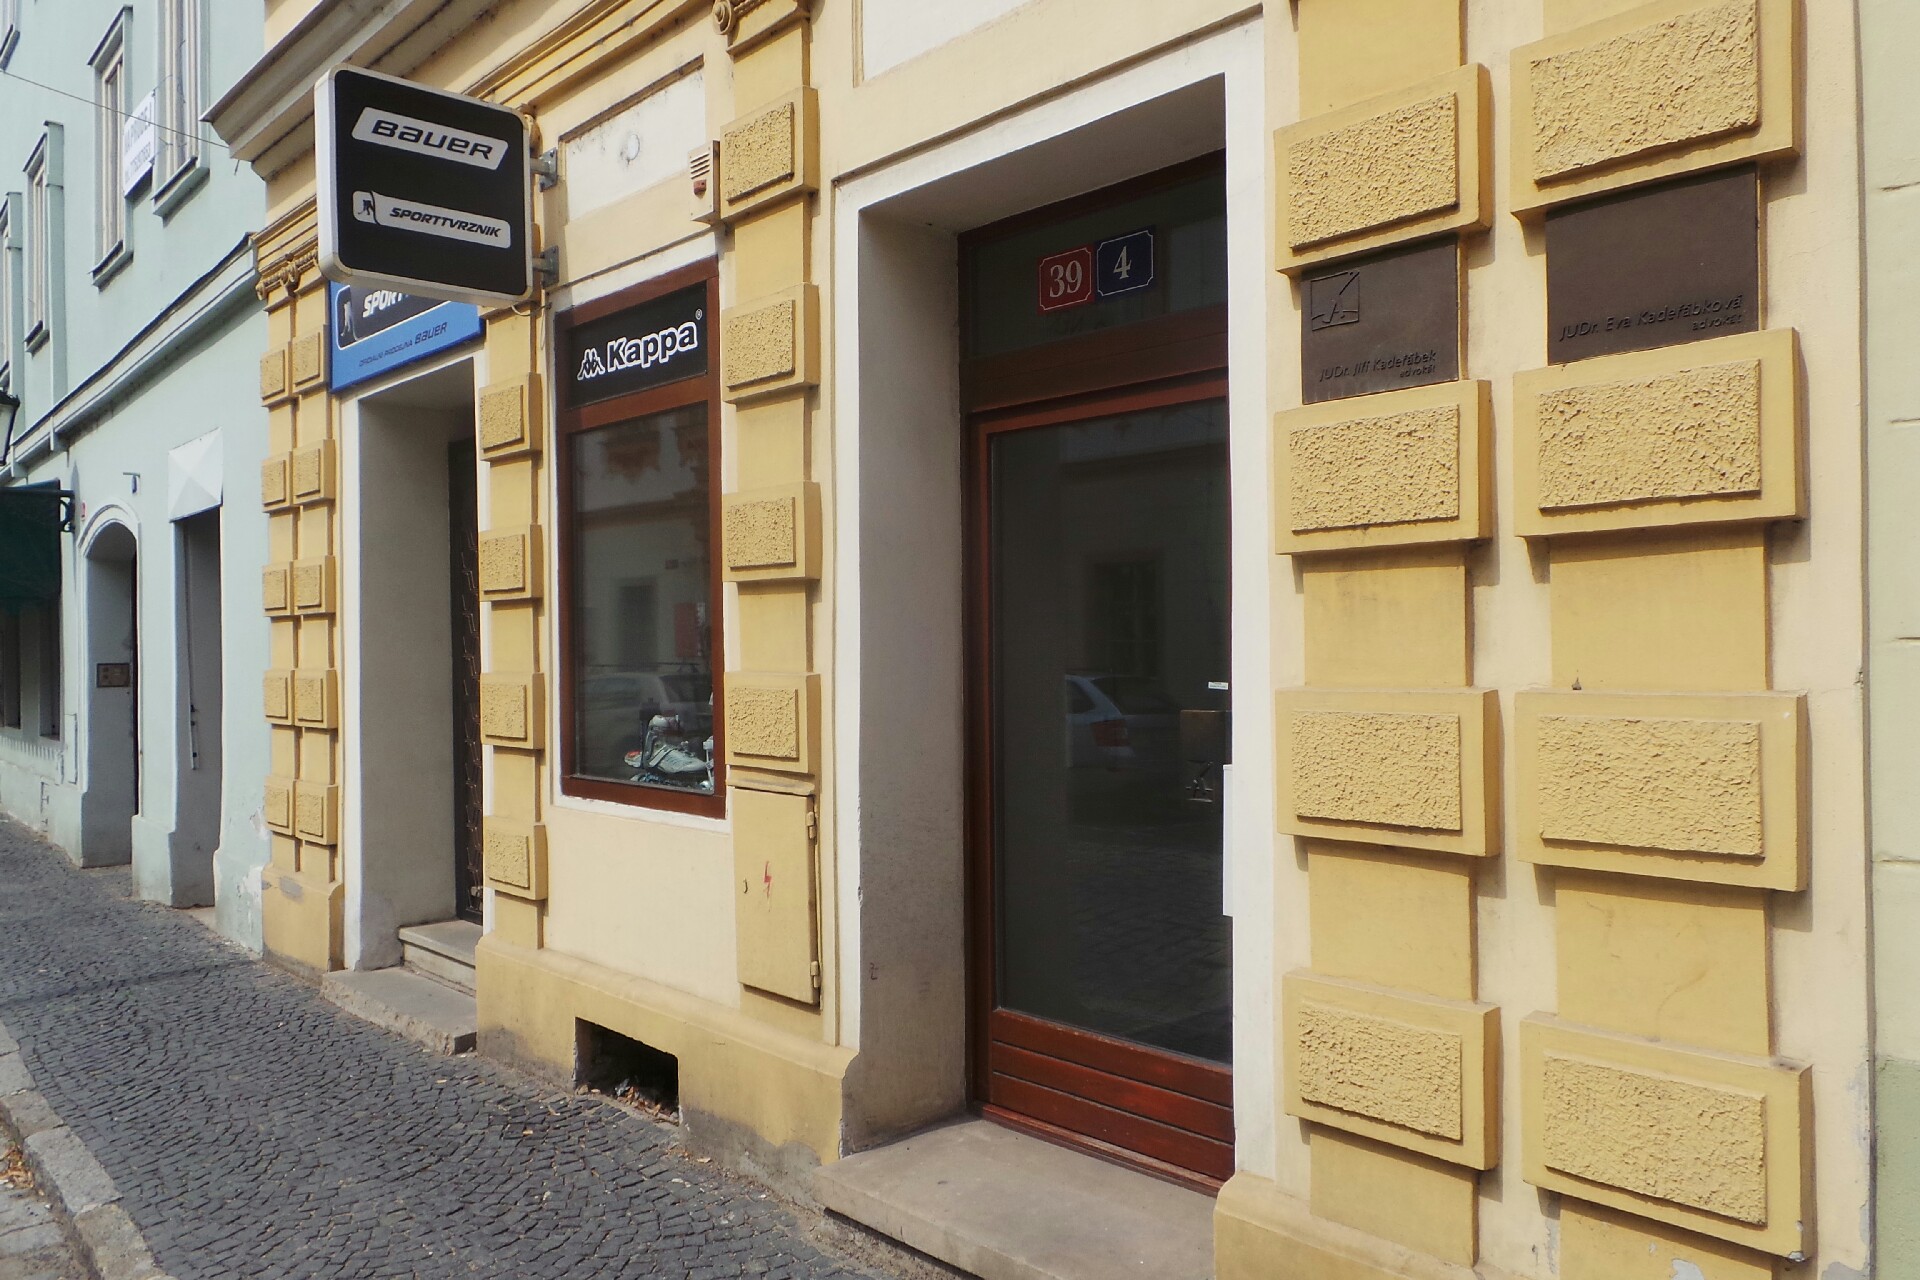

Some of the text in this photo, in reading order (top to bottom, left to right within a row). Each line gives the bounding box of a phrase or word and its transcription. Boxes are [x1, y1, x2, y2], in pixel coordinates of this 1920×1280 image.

[389, 207, 502, 238] SPORTTVRZNIK
[1049, 260, 1083, 298] 39
[1113, 245, 1132, 280] 4
[1605, 315, 1631, 332] Eva
[607, 321, 698, 372] Kappa
[1373, 349, 1437, 371] Kadeřábek
